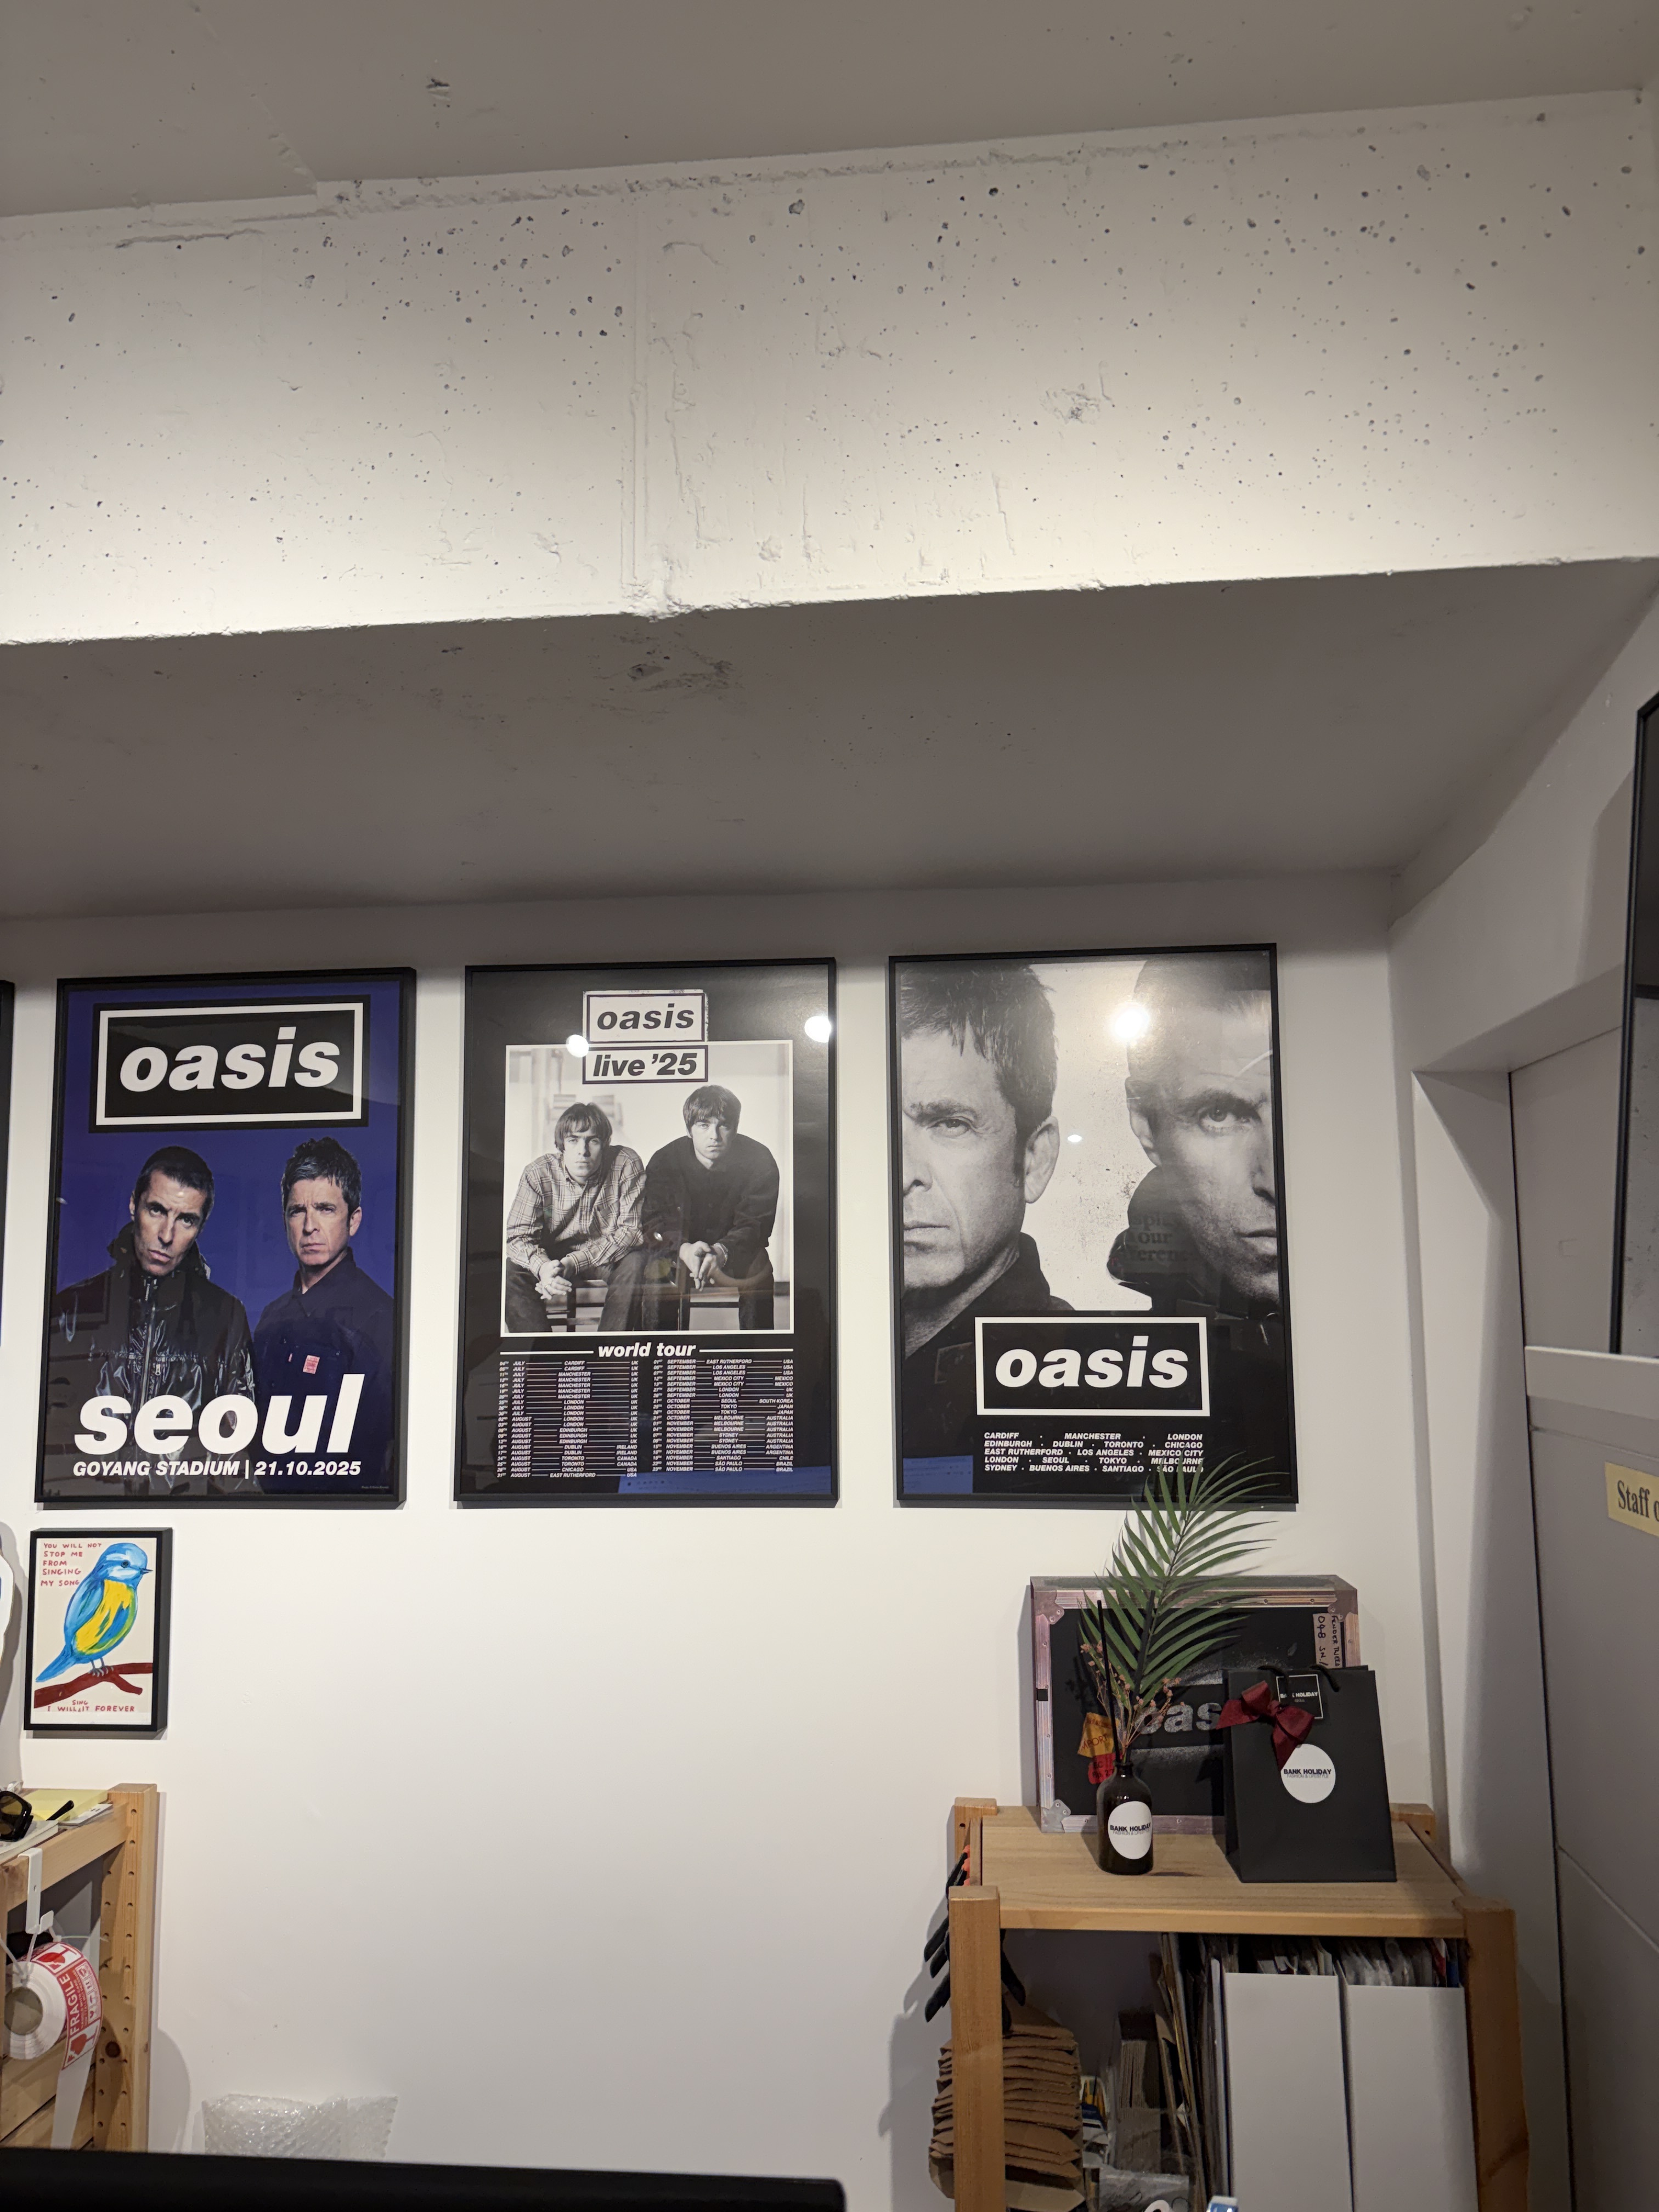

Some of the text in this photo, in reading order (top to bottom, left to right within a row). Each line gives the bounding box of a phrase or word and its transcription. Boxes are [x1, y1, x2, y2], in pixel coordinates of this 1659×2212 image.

[597, 1003, 694, 1030] oasis
[120, 1026, 340, 1092] oasis
[593, 1054, 645, 1077] live
[599, 1342, 696, 1357] world tour
[995, 1335, 1188, 1389] oasis
[74, 1374, 364, 1455] seoul
[73, 1460, 361, 1476] GOYANG STADIUM 21.10.2025
[1617, 1480, 1650, 1519] Staff
[1130, 1822, 1151, 1831] HOLIDAY
[59, 1973, 80, 2035] FRAGILE
